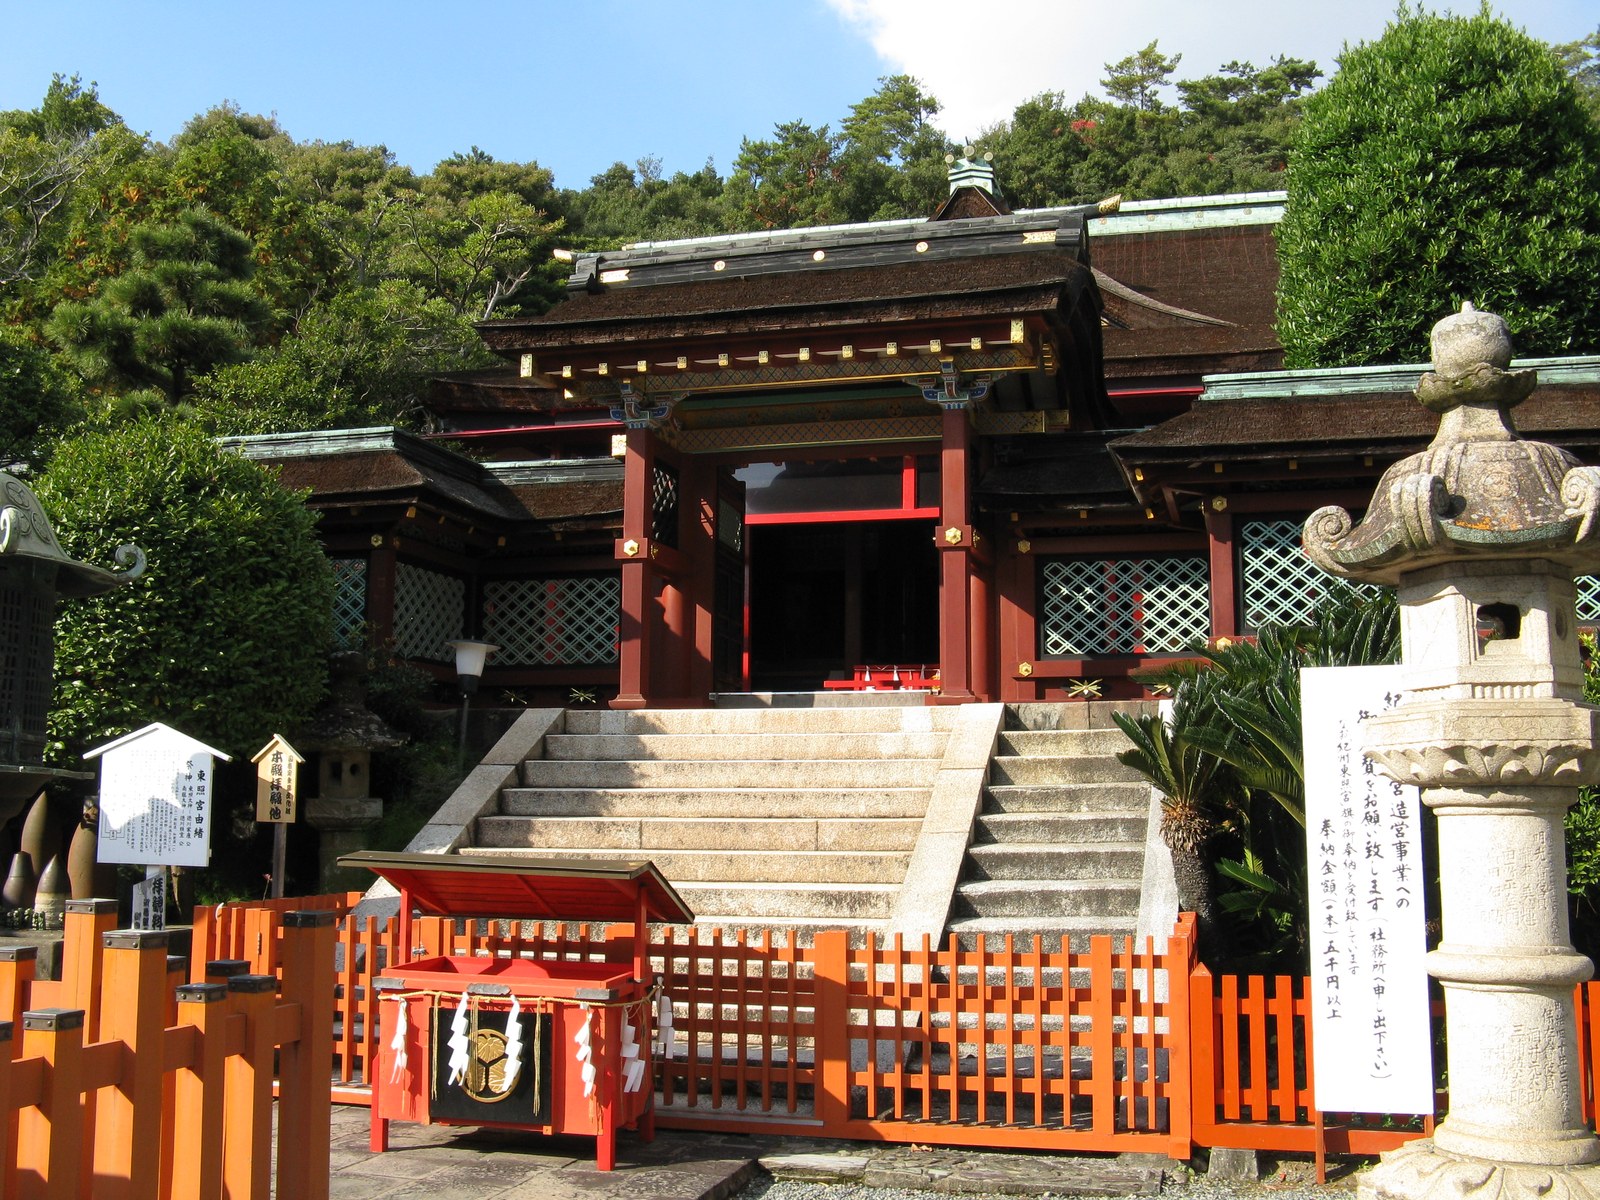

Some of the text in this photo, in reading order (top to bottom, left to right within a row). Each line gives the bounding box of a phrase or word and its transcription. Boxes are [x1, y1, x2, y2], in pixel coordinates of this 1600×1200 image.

[193, 769, 206, 839] 東照宮由緒
